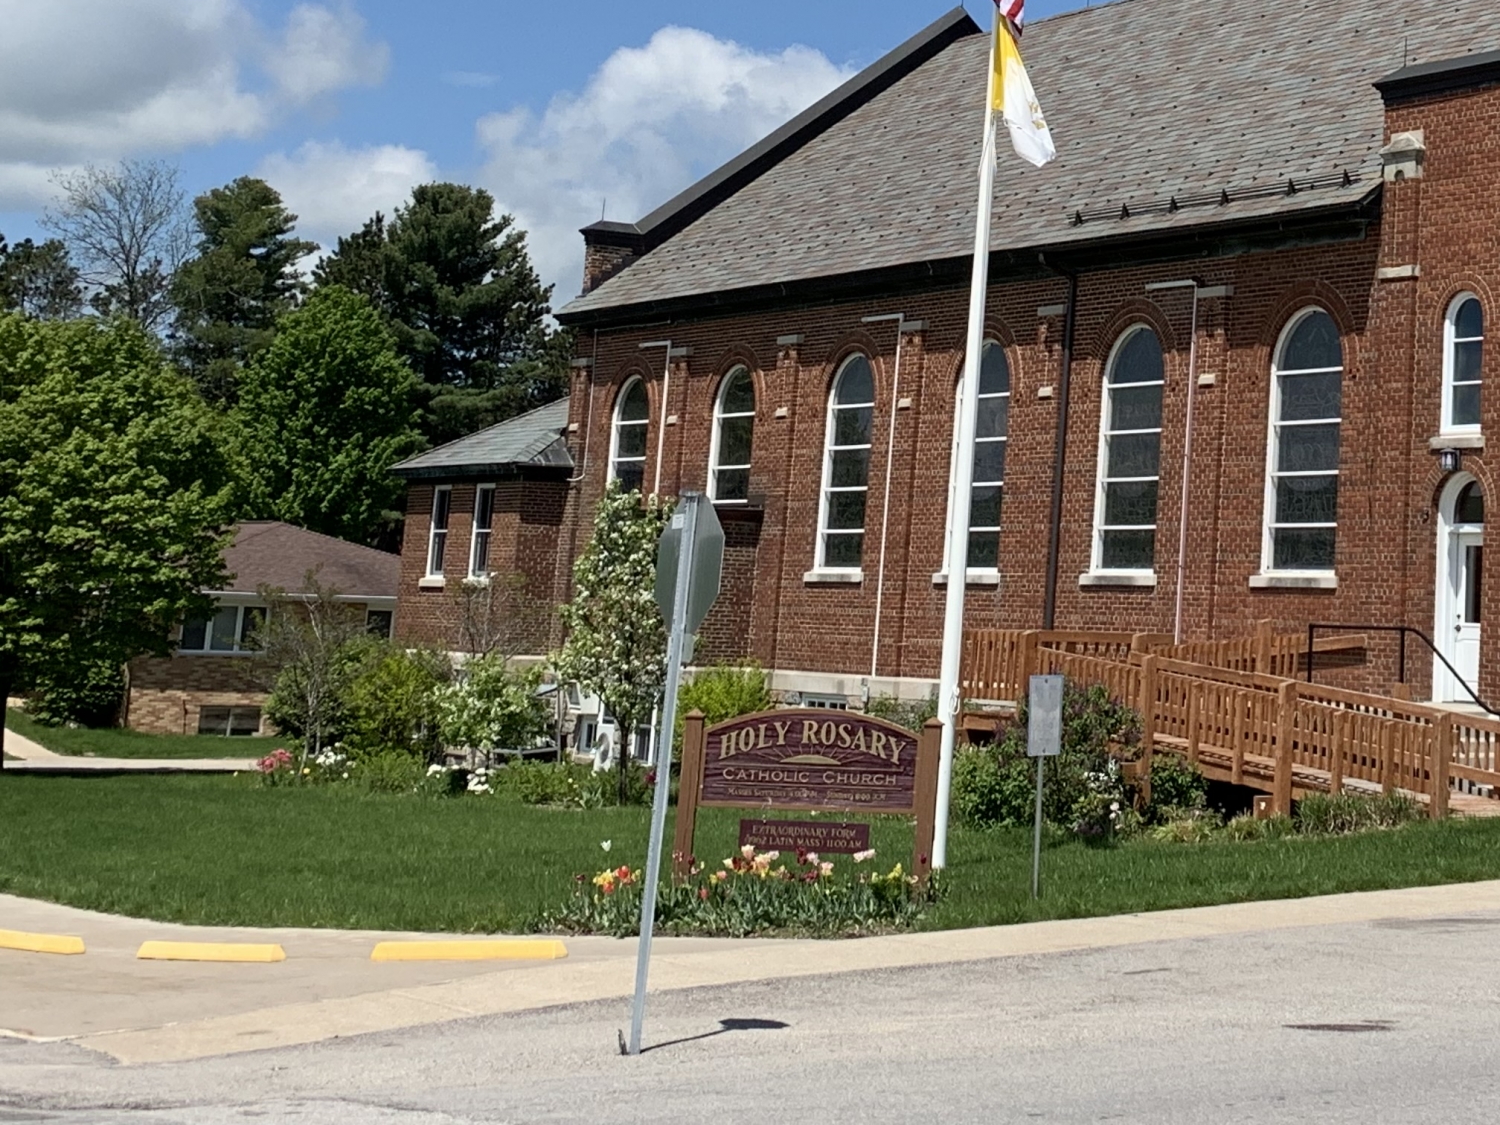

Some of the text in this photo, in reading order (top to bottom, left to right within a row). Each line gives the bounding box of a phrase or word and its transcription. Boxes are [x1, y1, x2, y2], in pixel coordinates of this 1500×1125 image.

[718, 719, 907, 764] HOLY ROSARY
[722, 767, 897, 785] CATHOLIC CHURCH
[752, 825, 857, 840] EXTRAORDINARY FORM
[768, 837, 794, 846] LATIN
[796, 838, 824, 848] MASS)
[847, 839, 862, 849] AM
